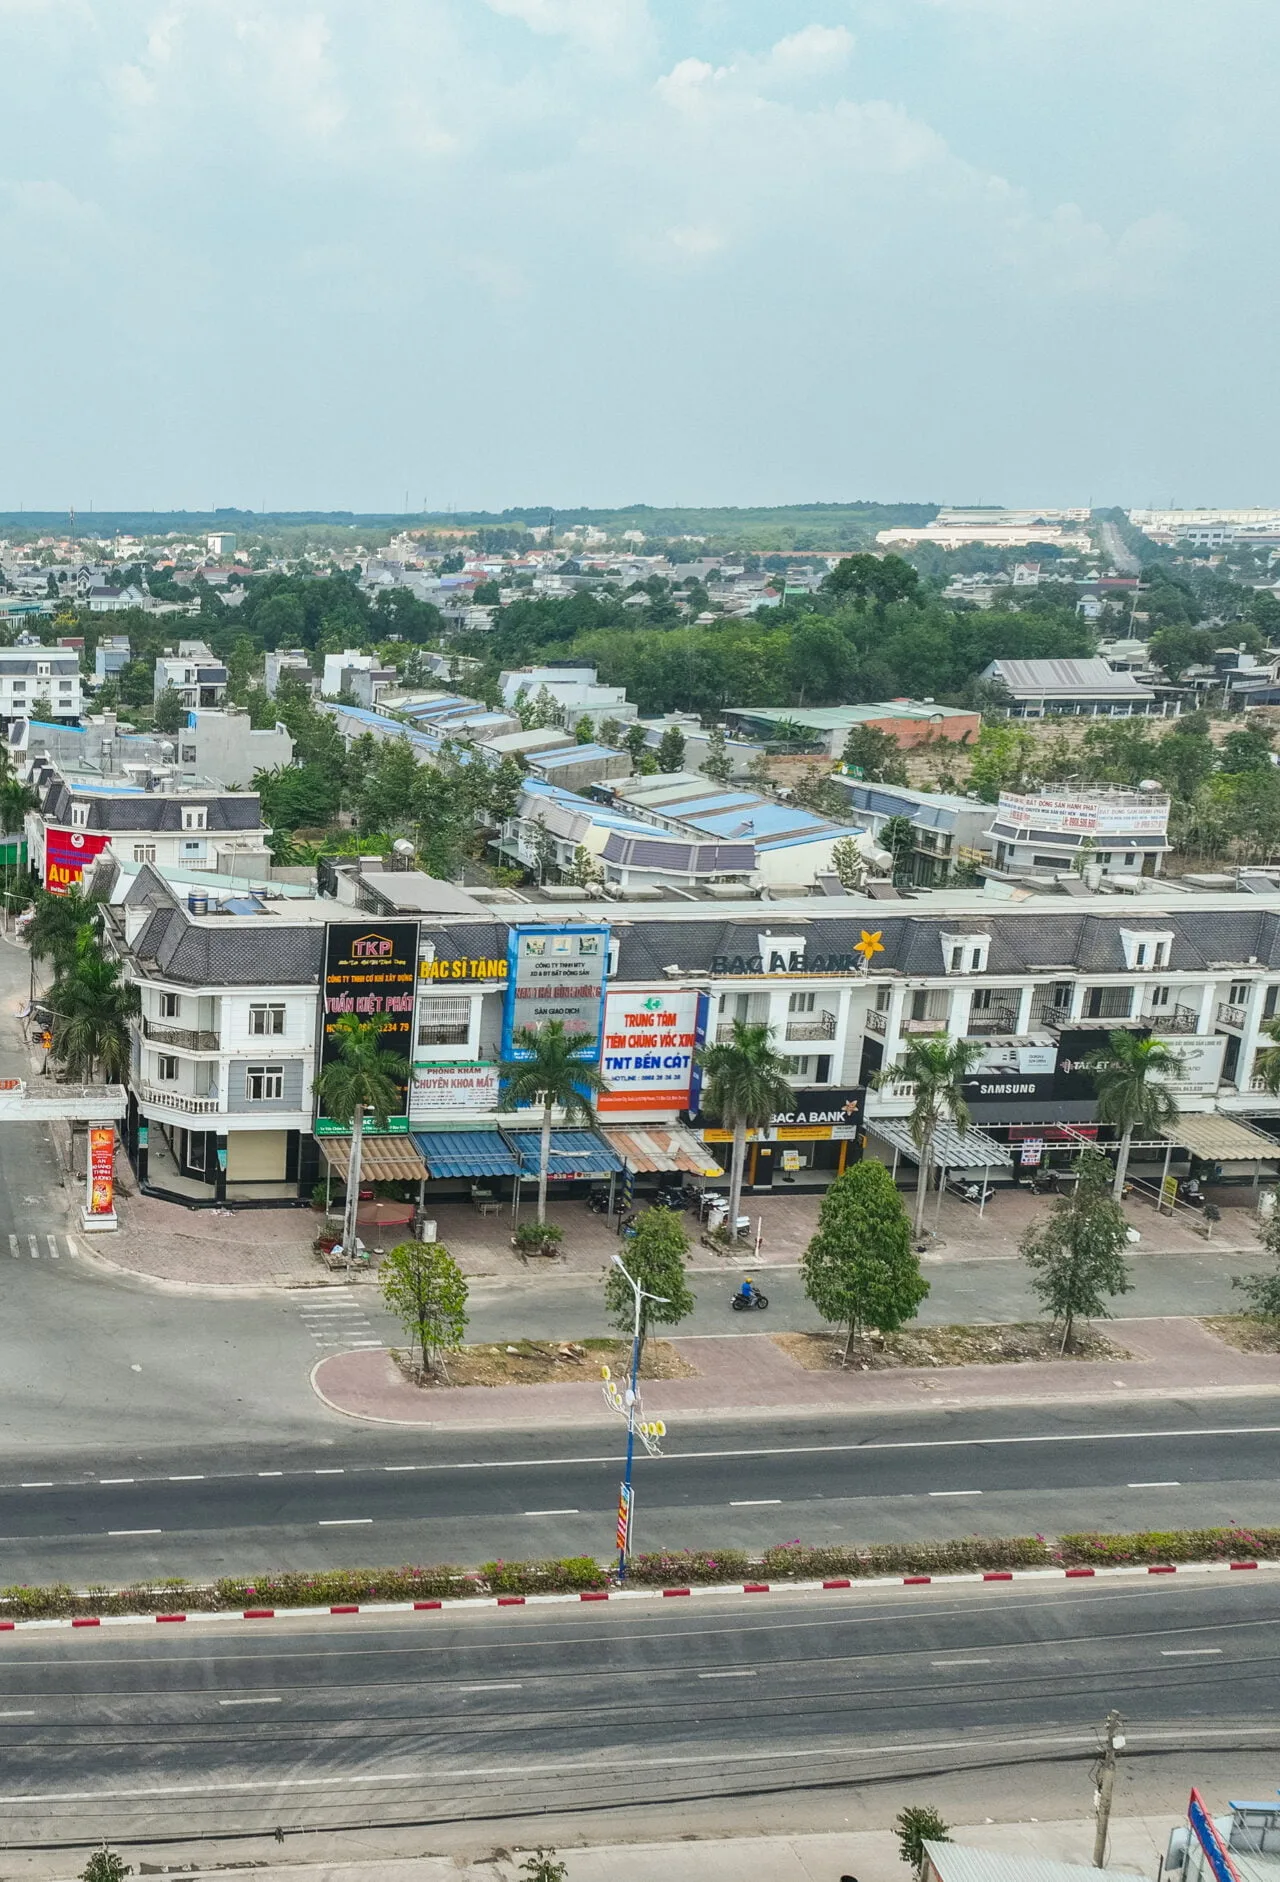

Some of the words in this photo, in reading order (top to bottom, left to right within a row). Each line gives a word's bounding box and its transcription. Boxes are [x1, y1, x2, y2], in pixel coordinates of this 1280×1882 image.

[354, 941, 391, 956] TKP
[420, 955, 450, 979] BÁC
[451, 956, 467, 979] SĨ
[470, 956, 508, 982] TẶNG
[711, 955, 764, 974] BAC
[789, 953, 861, 973] BANK
[327, 974, 341, 983] CÔNG
[563, 969, 578, 977] ĐỘNG
[579, 968, 590, 976] SẢN
[326, 991, 355, 1013] TUẤN
[356, 992, 383, 1015] KIỆT
[385, 992, 414, 1012] PHÁT
[565, 1007, 580, 1015] DỊCH
[624, 1013, 654, 1027] TRUNG
[657, 1010, 677, 1027] TÂM
[606, 1032, 626, 1049] TIÊM
[679, 1033, 695, 1047] XIN
[605, 1057, 632, 1070] TNT
[634, 1051, 661, 1069] BẾN
[664, 1052, 690, 1068] CÁT
[427, 1066, 455, 1075] PHÒNG
[458, 1066, 482, 1074] KHÁM
[414, 1078, 449, 1089] CHUYÊN
[451, 1078, 475, 1088] KHOA
[980, 1084, 1036, 1095] SAMSUNG
[770, 1112, 795, 1123] BAC
[796, 1111, 808, 1123] A
[809, 1111, 846, 1122] BANK
